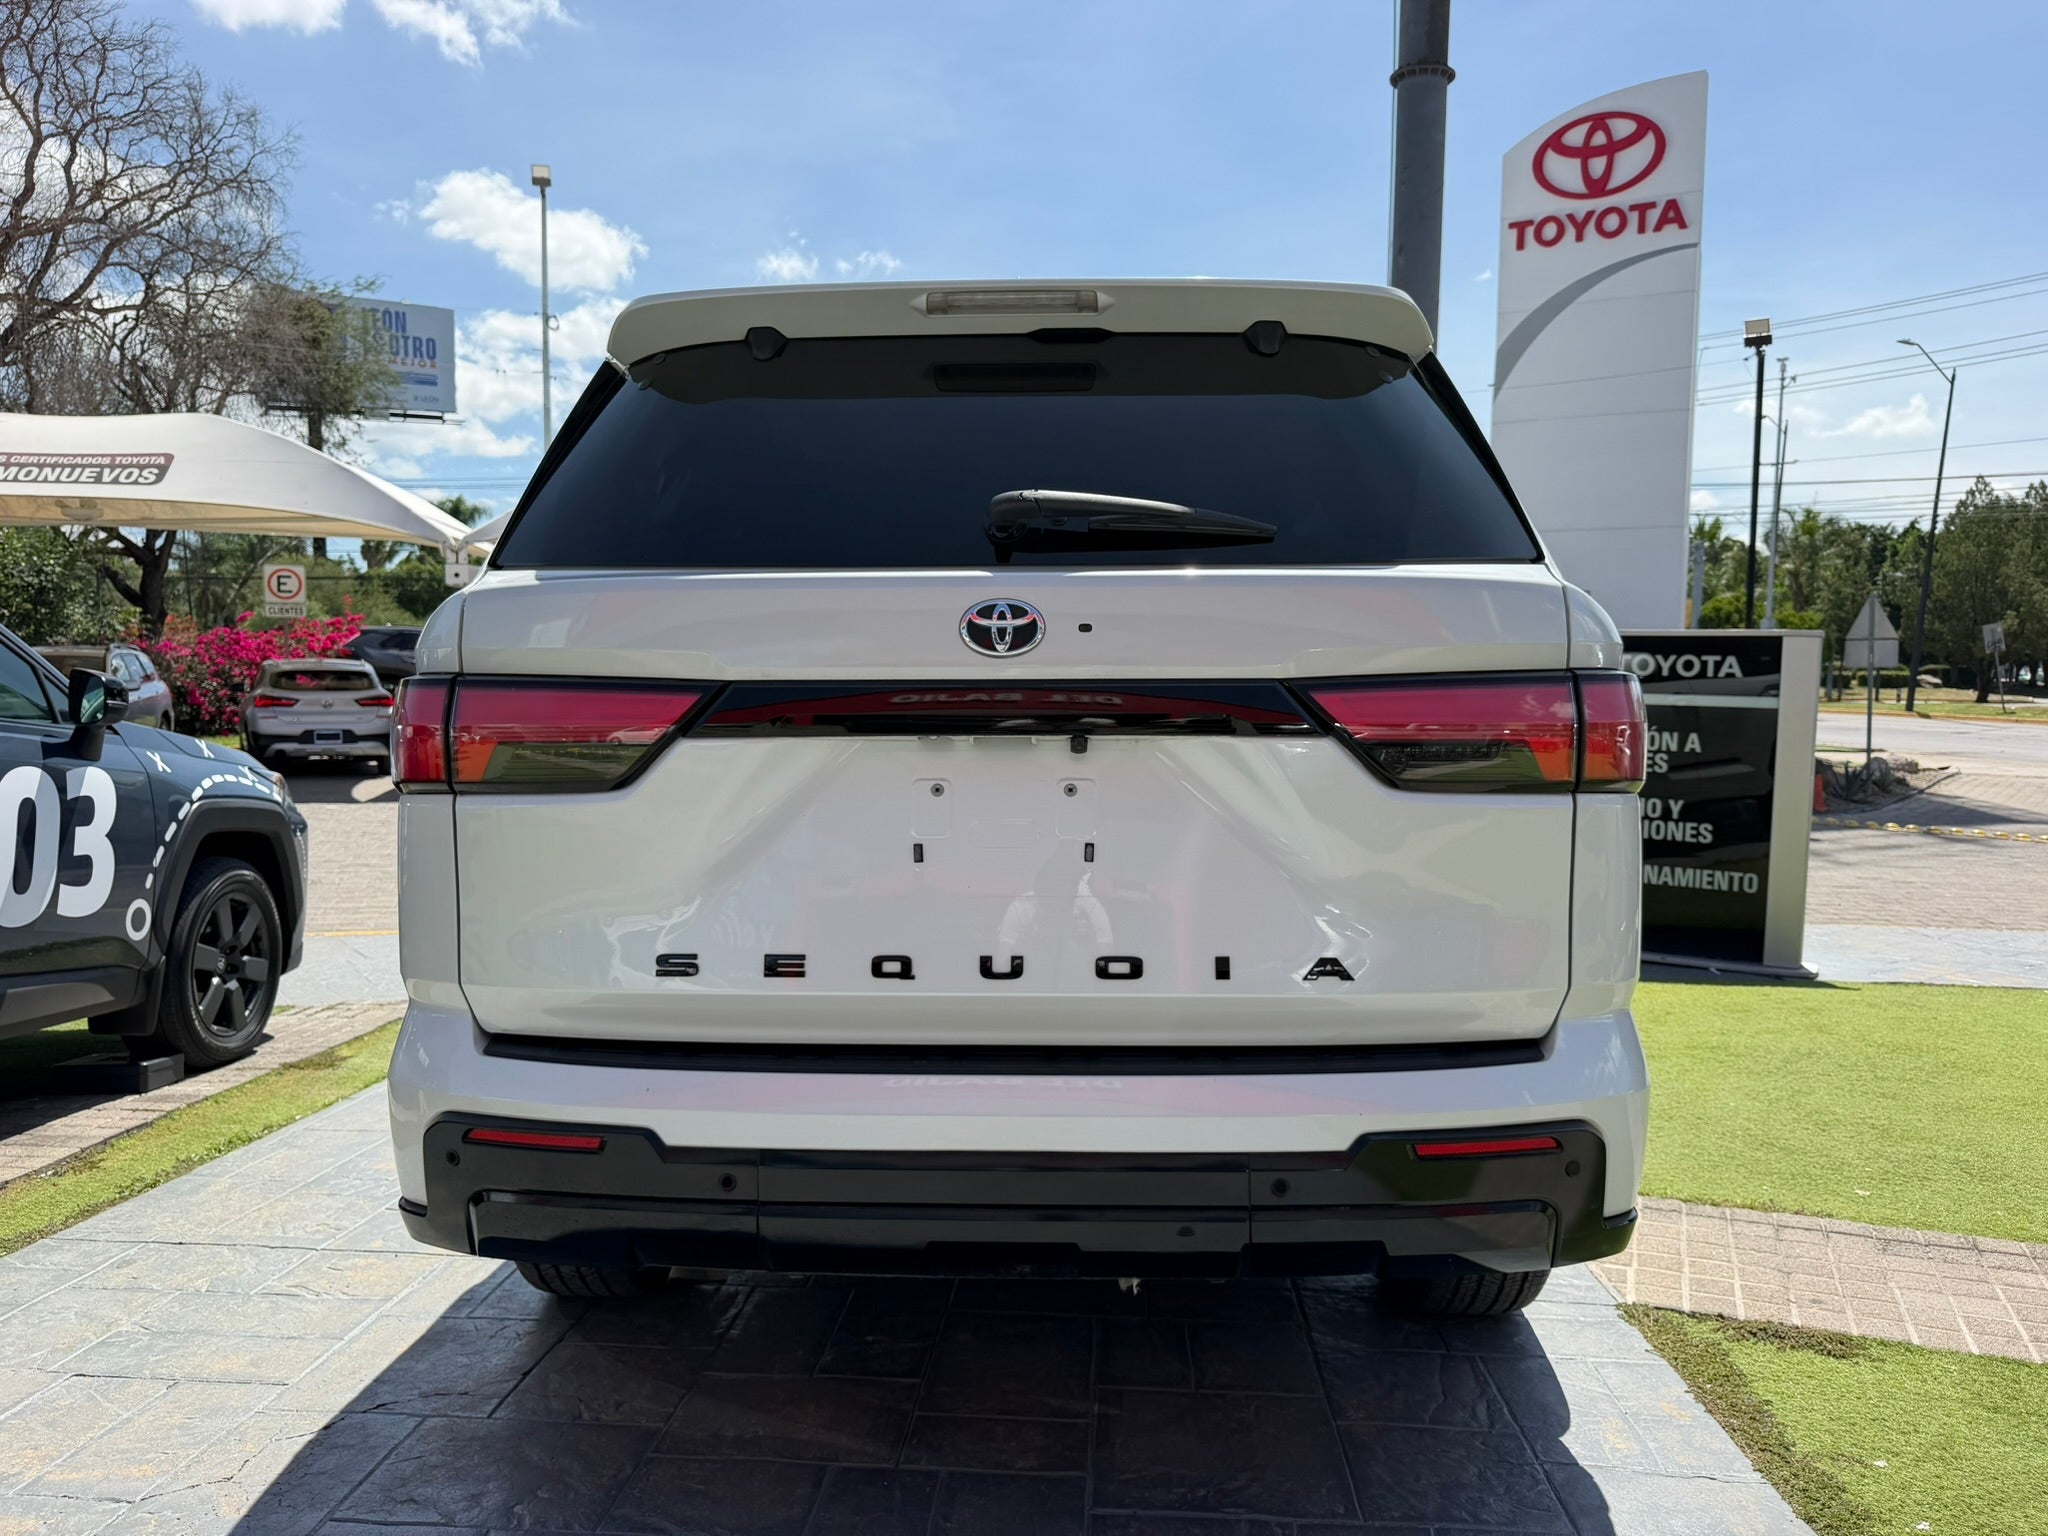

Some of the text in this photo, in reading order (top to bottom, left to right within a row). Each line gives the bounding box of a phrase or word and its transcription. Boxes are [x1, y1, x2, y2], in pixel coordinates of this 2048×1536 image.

[1508, 199, 1688, 251] TOYOTA
[10, 455, 111, 465] CERTIFICADOS
[114, 456, 165, 465] TOYOTA
[277, 575, 293, 593] E
[268, 606, 305, 616] CLIENTES
[1684, 732, 1703, 753] A
[1668, 799, 1684, 819] Y
[0, 766, 117, 928] 03
[655, 953, 1355, 981] SEQUOIA
